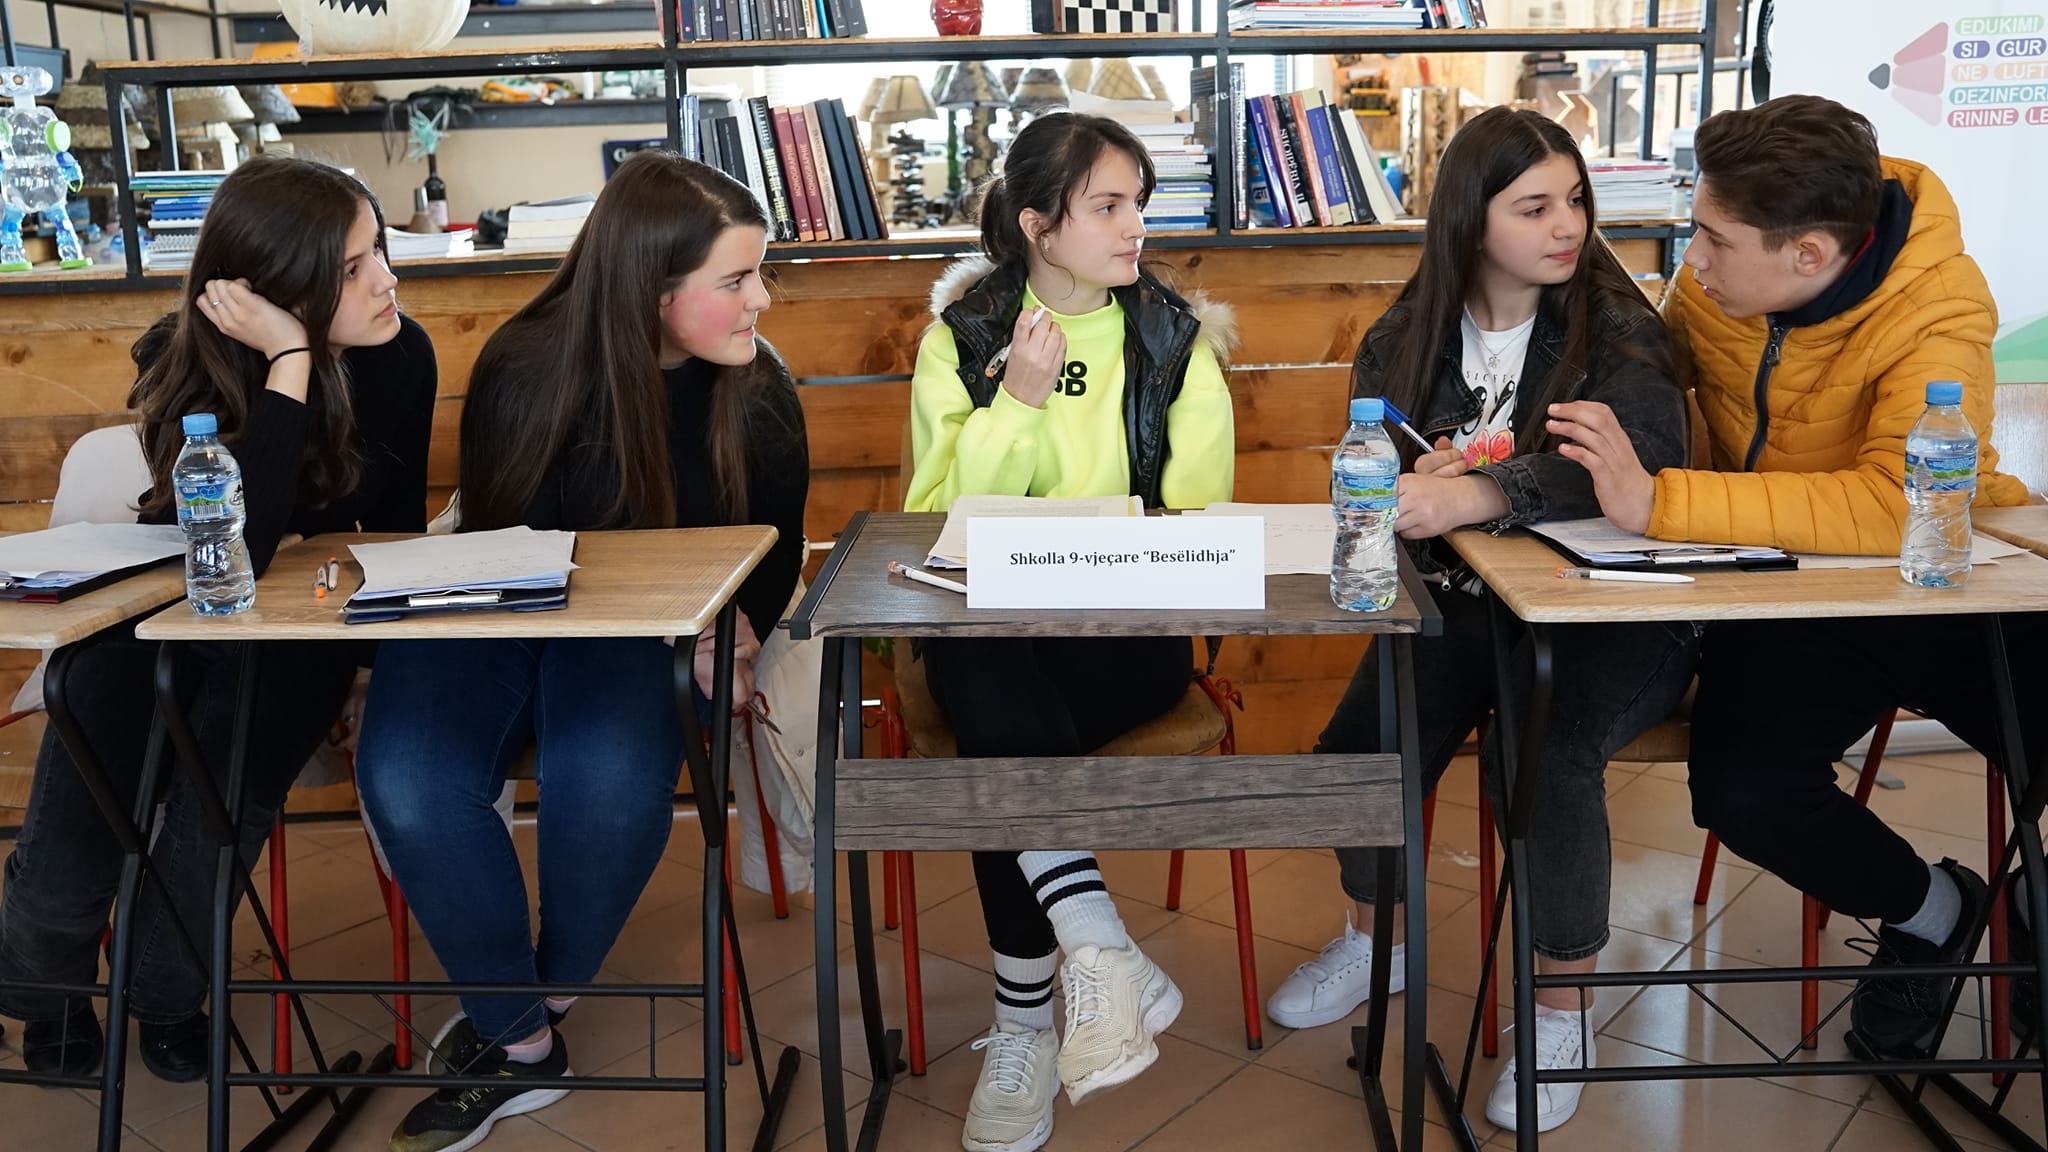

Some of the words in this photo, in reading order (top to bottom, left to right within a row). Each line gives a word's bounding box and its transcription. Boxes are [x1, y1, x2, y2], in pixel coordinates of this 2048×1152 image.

[1960, 16, 2038, 35] EDUKIMI
[1960, 42, 1978, 57] SI
[2001, 39, 2042, 56] GUR
[1957, 65, 1982, 80] NE
[1954, 86, 2048, 104] DEZINFOR
[1952, 109, 2014, 127] RININE
[1010, 552, 1065, 566] Shkolla
[1070, 551, 1139, 567] 9-vjeçare
[1143, 548, 1236, 564] “Besëlidhja”
